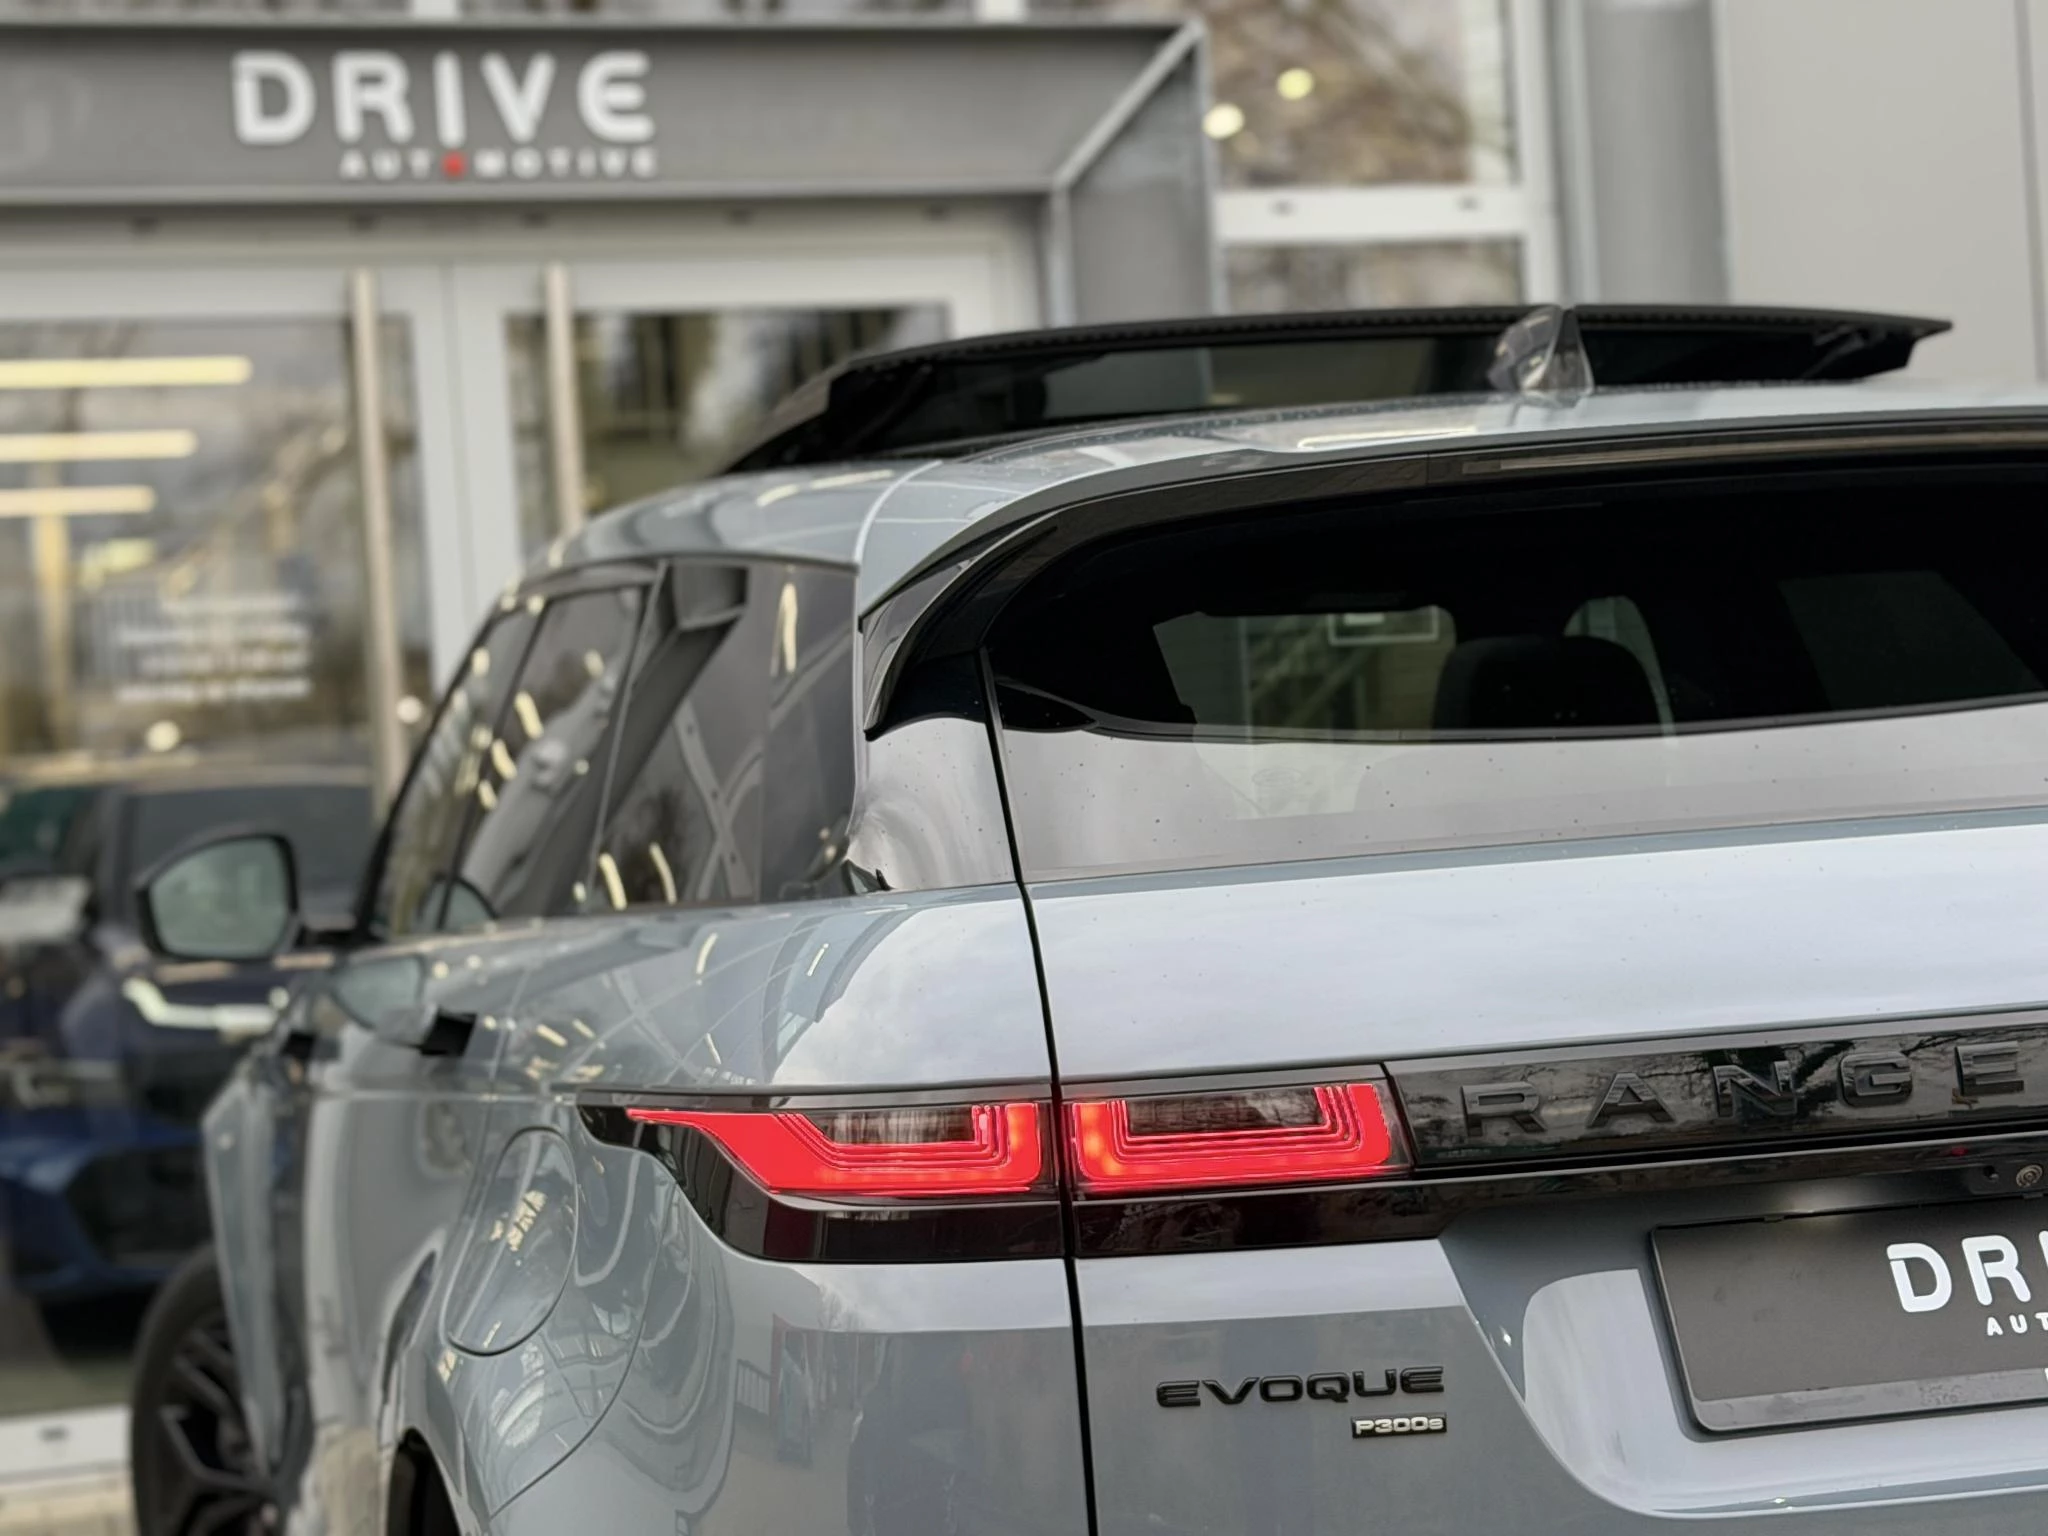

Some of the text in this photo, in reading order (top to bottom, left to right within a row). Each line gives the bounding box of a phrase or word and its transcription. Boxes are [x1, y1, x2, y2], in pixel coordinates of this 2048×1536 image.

[231, 49, 656, 149] DRIVE
[1461, 1040, 2025, 1138] RANGE
[1155, 1366, 1445, 1408] EVOQUE
[1354, 1415, 1445, 1436] P300e
